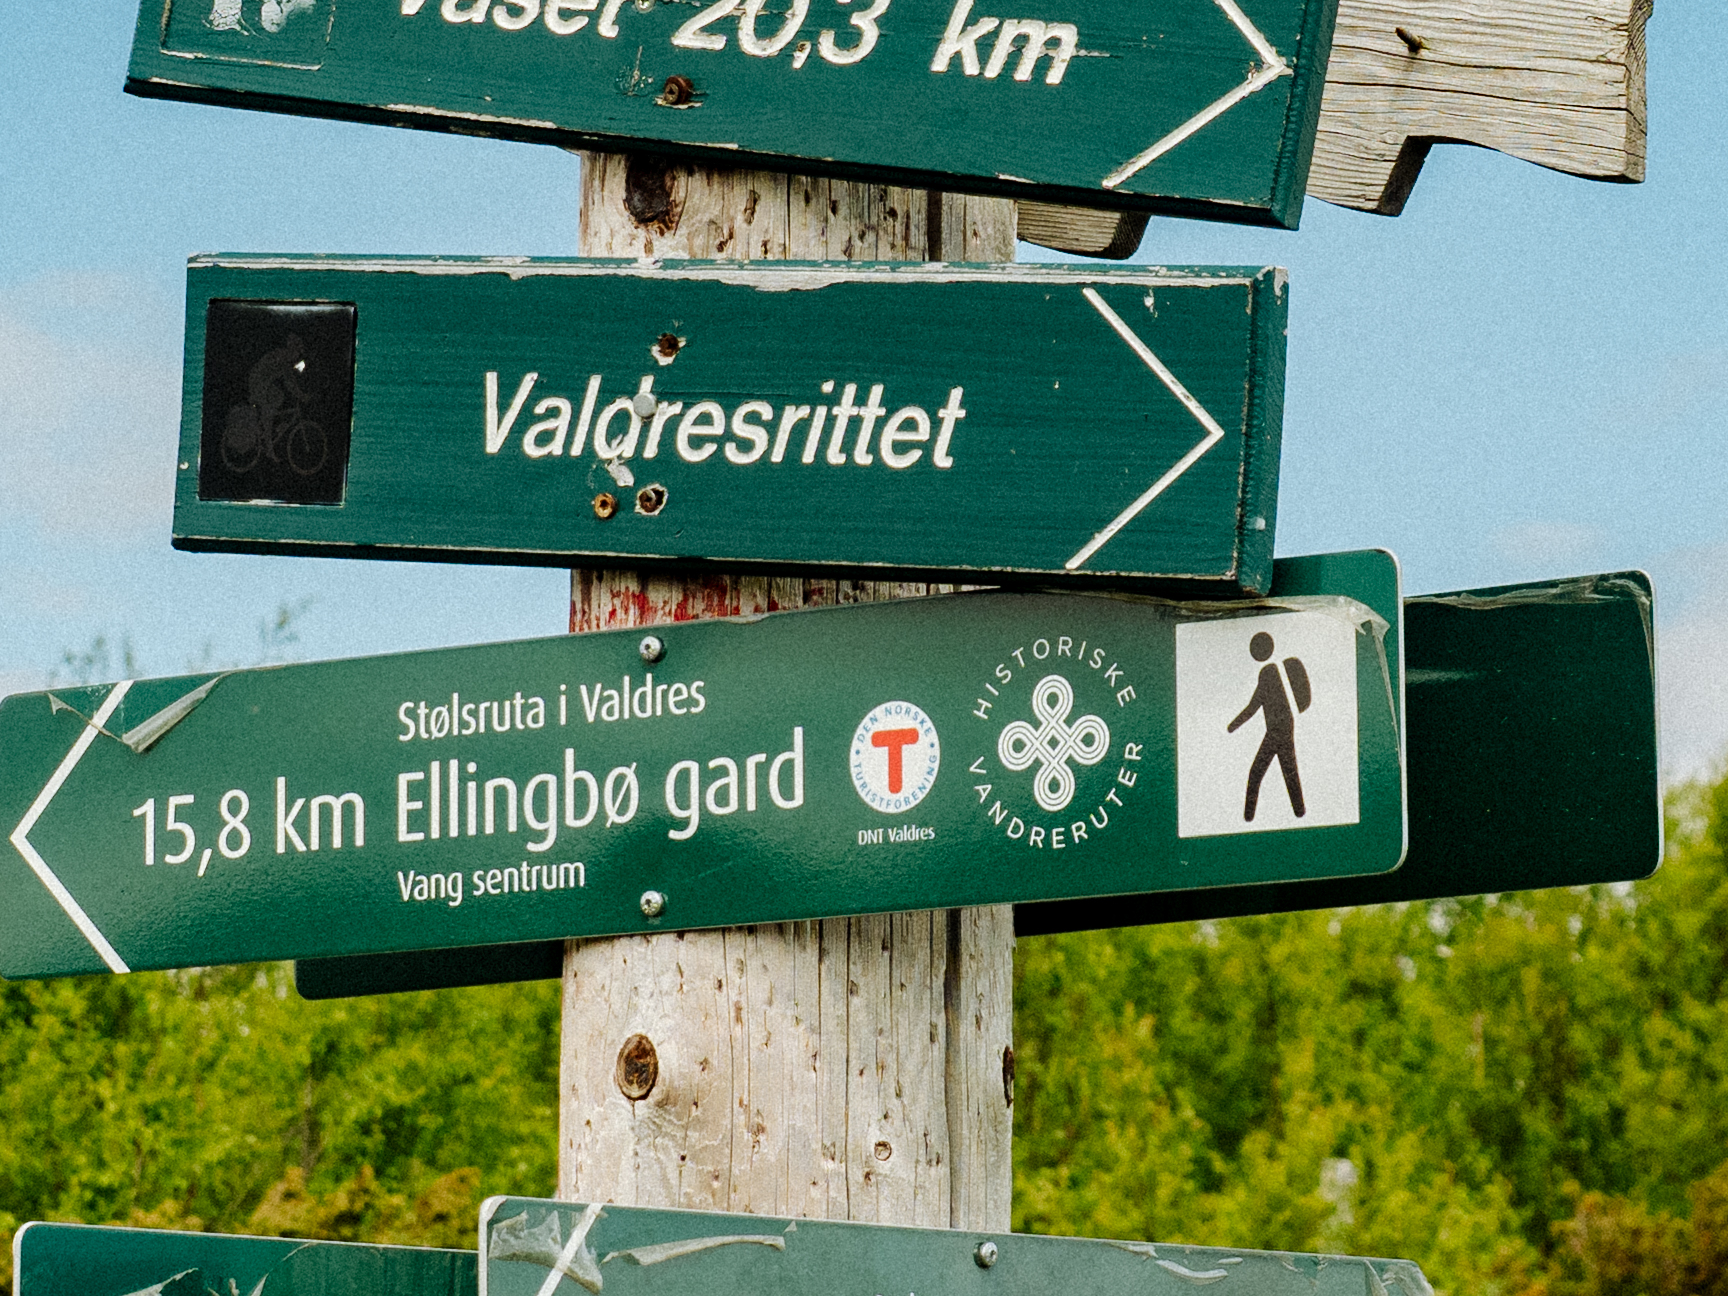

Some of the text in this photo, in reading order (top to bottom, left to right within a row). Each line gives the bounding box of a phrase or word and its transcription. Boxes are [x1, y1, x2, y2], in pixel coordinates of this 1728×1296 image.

[483, 370, 967, 470] Valdresrittet
[397, 672, 707, 742] Stølsruta i Valdres
[972, 635, 1137, 720] HISTORISKE
[856, 704, 934, 744] DEN NORSKE
[853, 754, 938, 810] TURISTFORENING
[870, 726, 920, 795] T
[968, 740, 1144, 850] VANDRERUTER
[132, 726, 806, 878] 15,8 km Ellingbø gard
[857, 824, 936, 846] DNT Valdres
[397, 859, 586, 907] Vang sentrum
